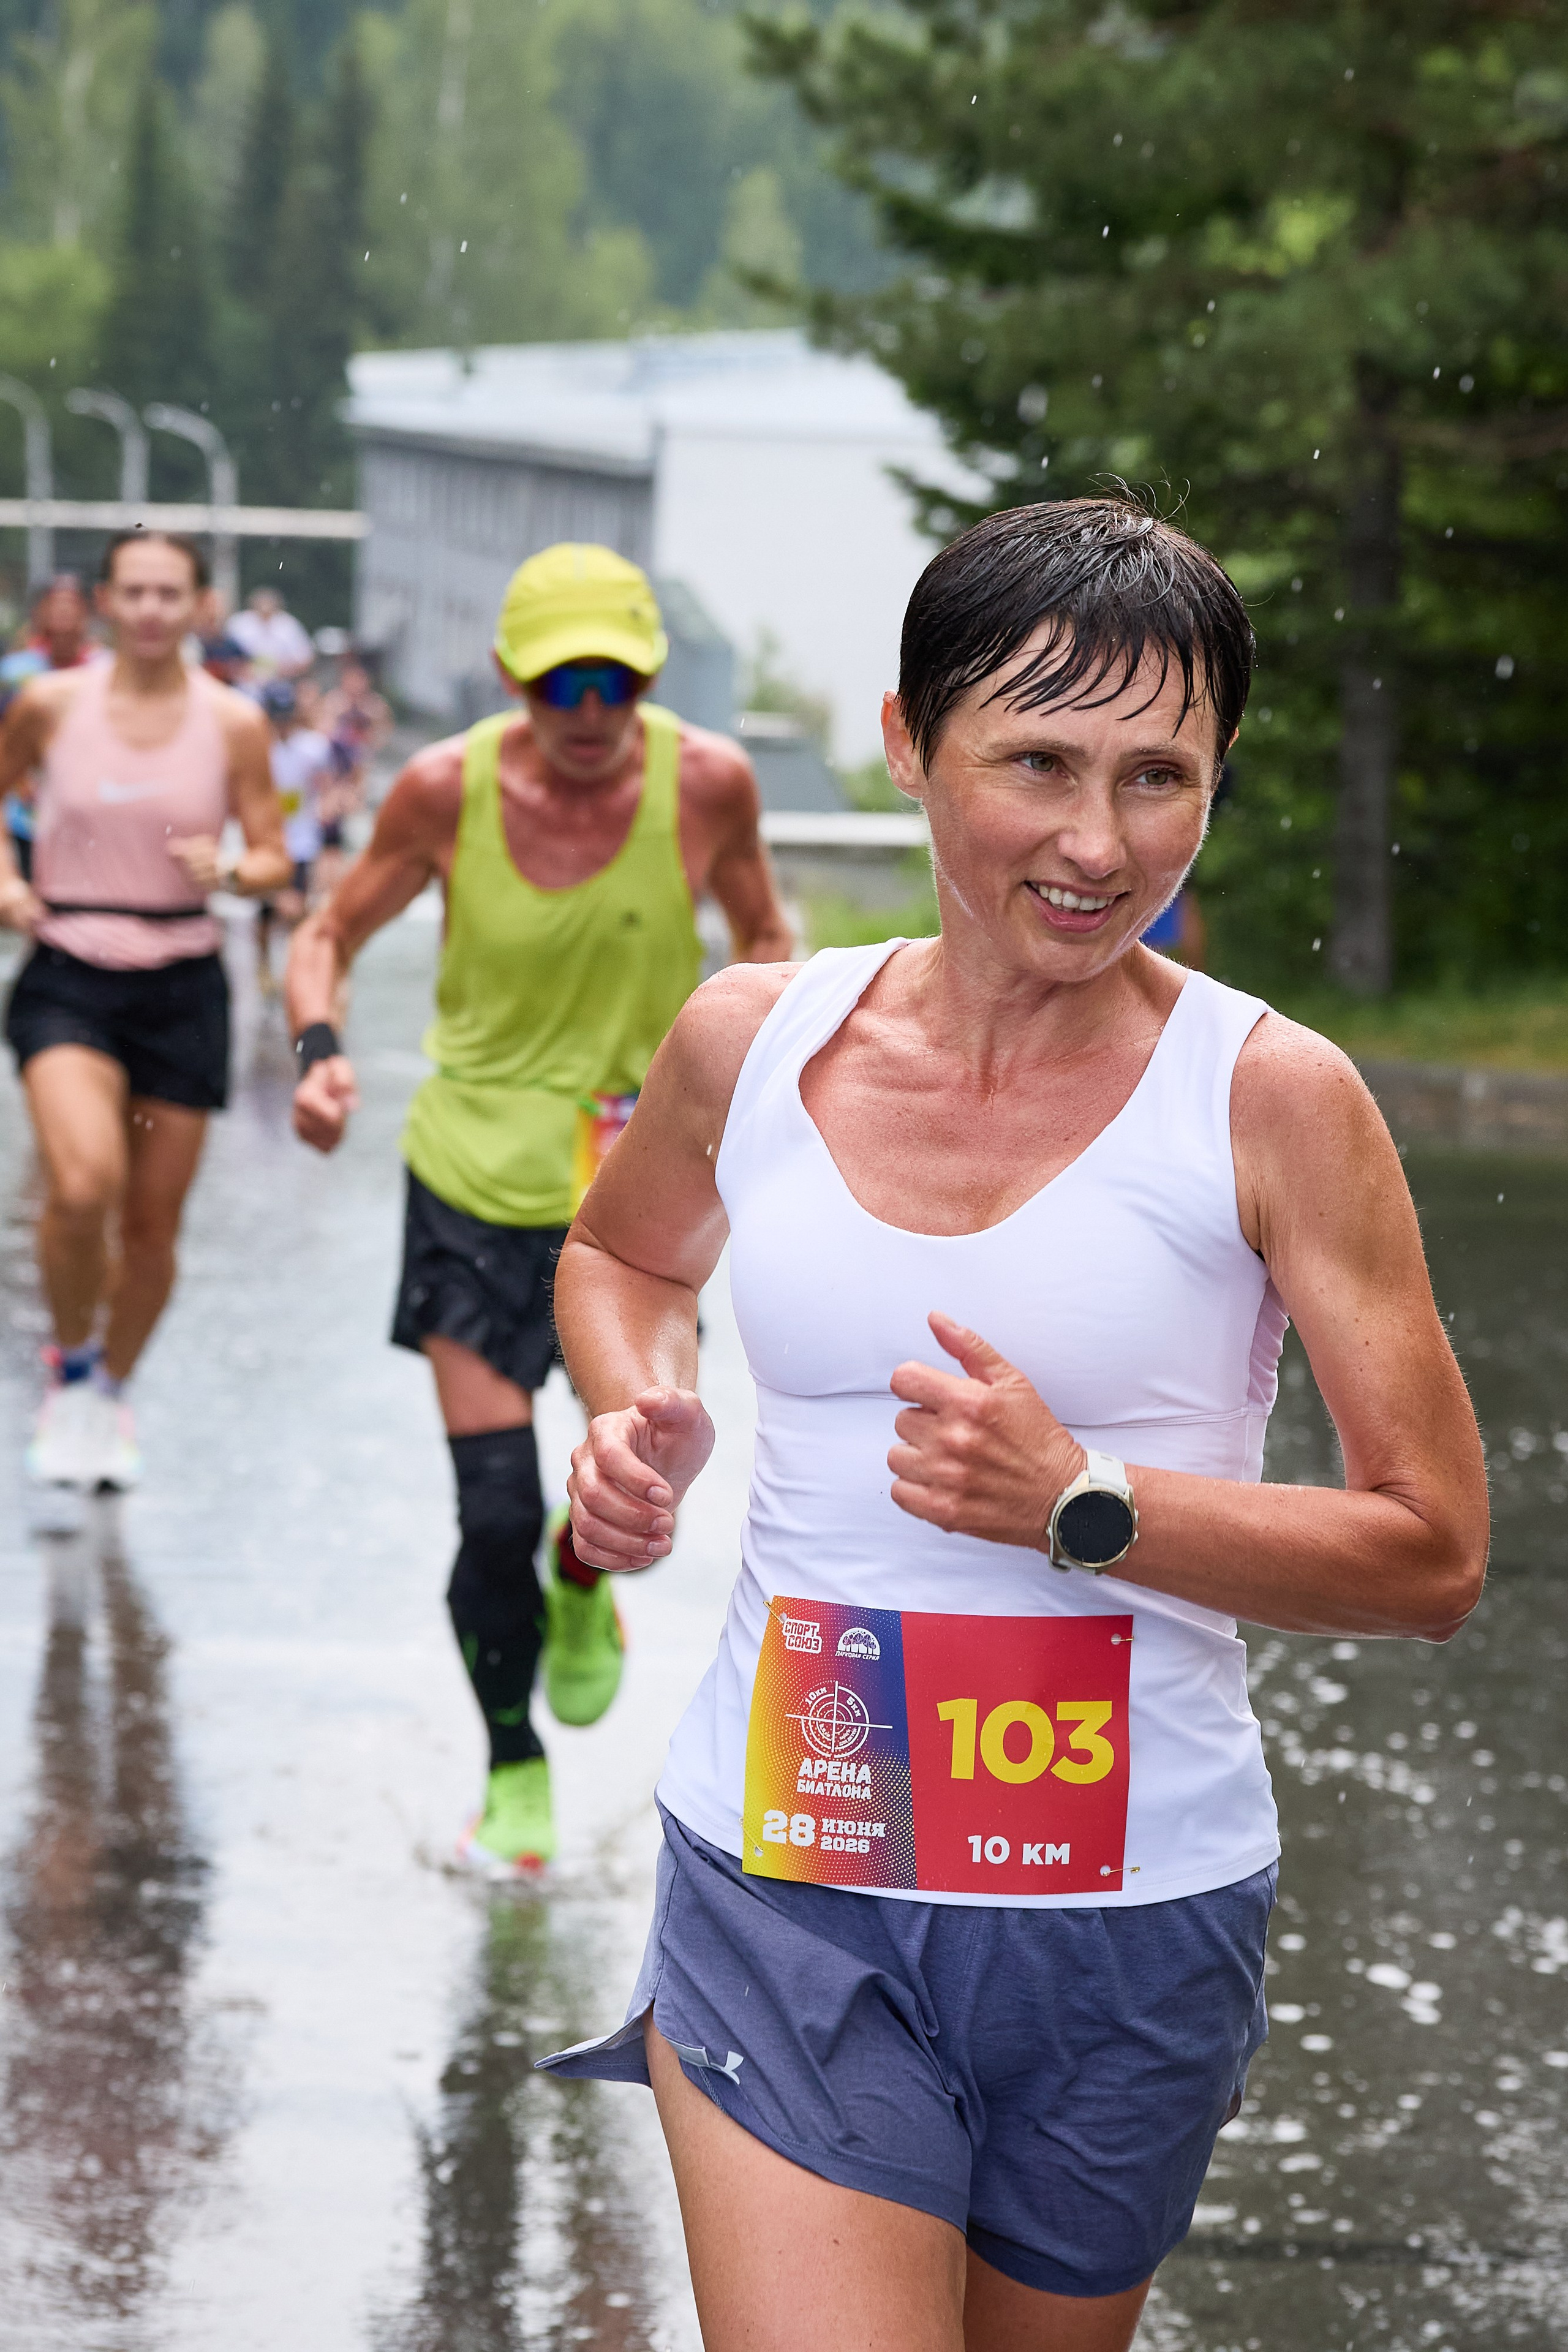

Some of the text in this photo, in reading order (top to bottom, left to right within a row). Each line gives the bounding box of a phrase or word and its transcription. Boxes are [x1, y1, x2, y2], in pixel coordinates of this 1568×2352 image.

[785, 1621, 817, 1637] СПОРТ
[788, 1635, 820, 1651] СОЮЗ
[937, 1698, 1115, 1784] 103
[798, 1758, 872, 1784] АРЕНА
[796, 1779, 872, 1800] БИАТЛОНА
[763, 1809, 816, 1847] 28
[820, 1836, 870, 1853] 2026
[968, 1835, 1010, 1864] 10
